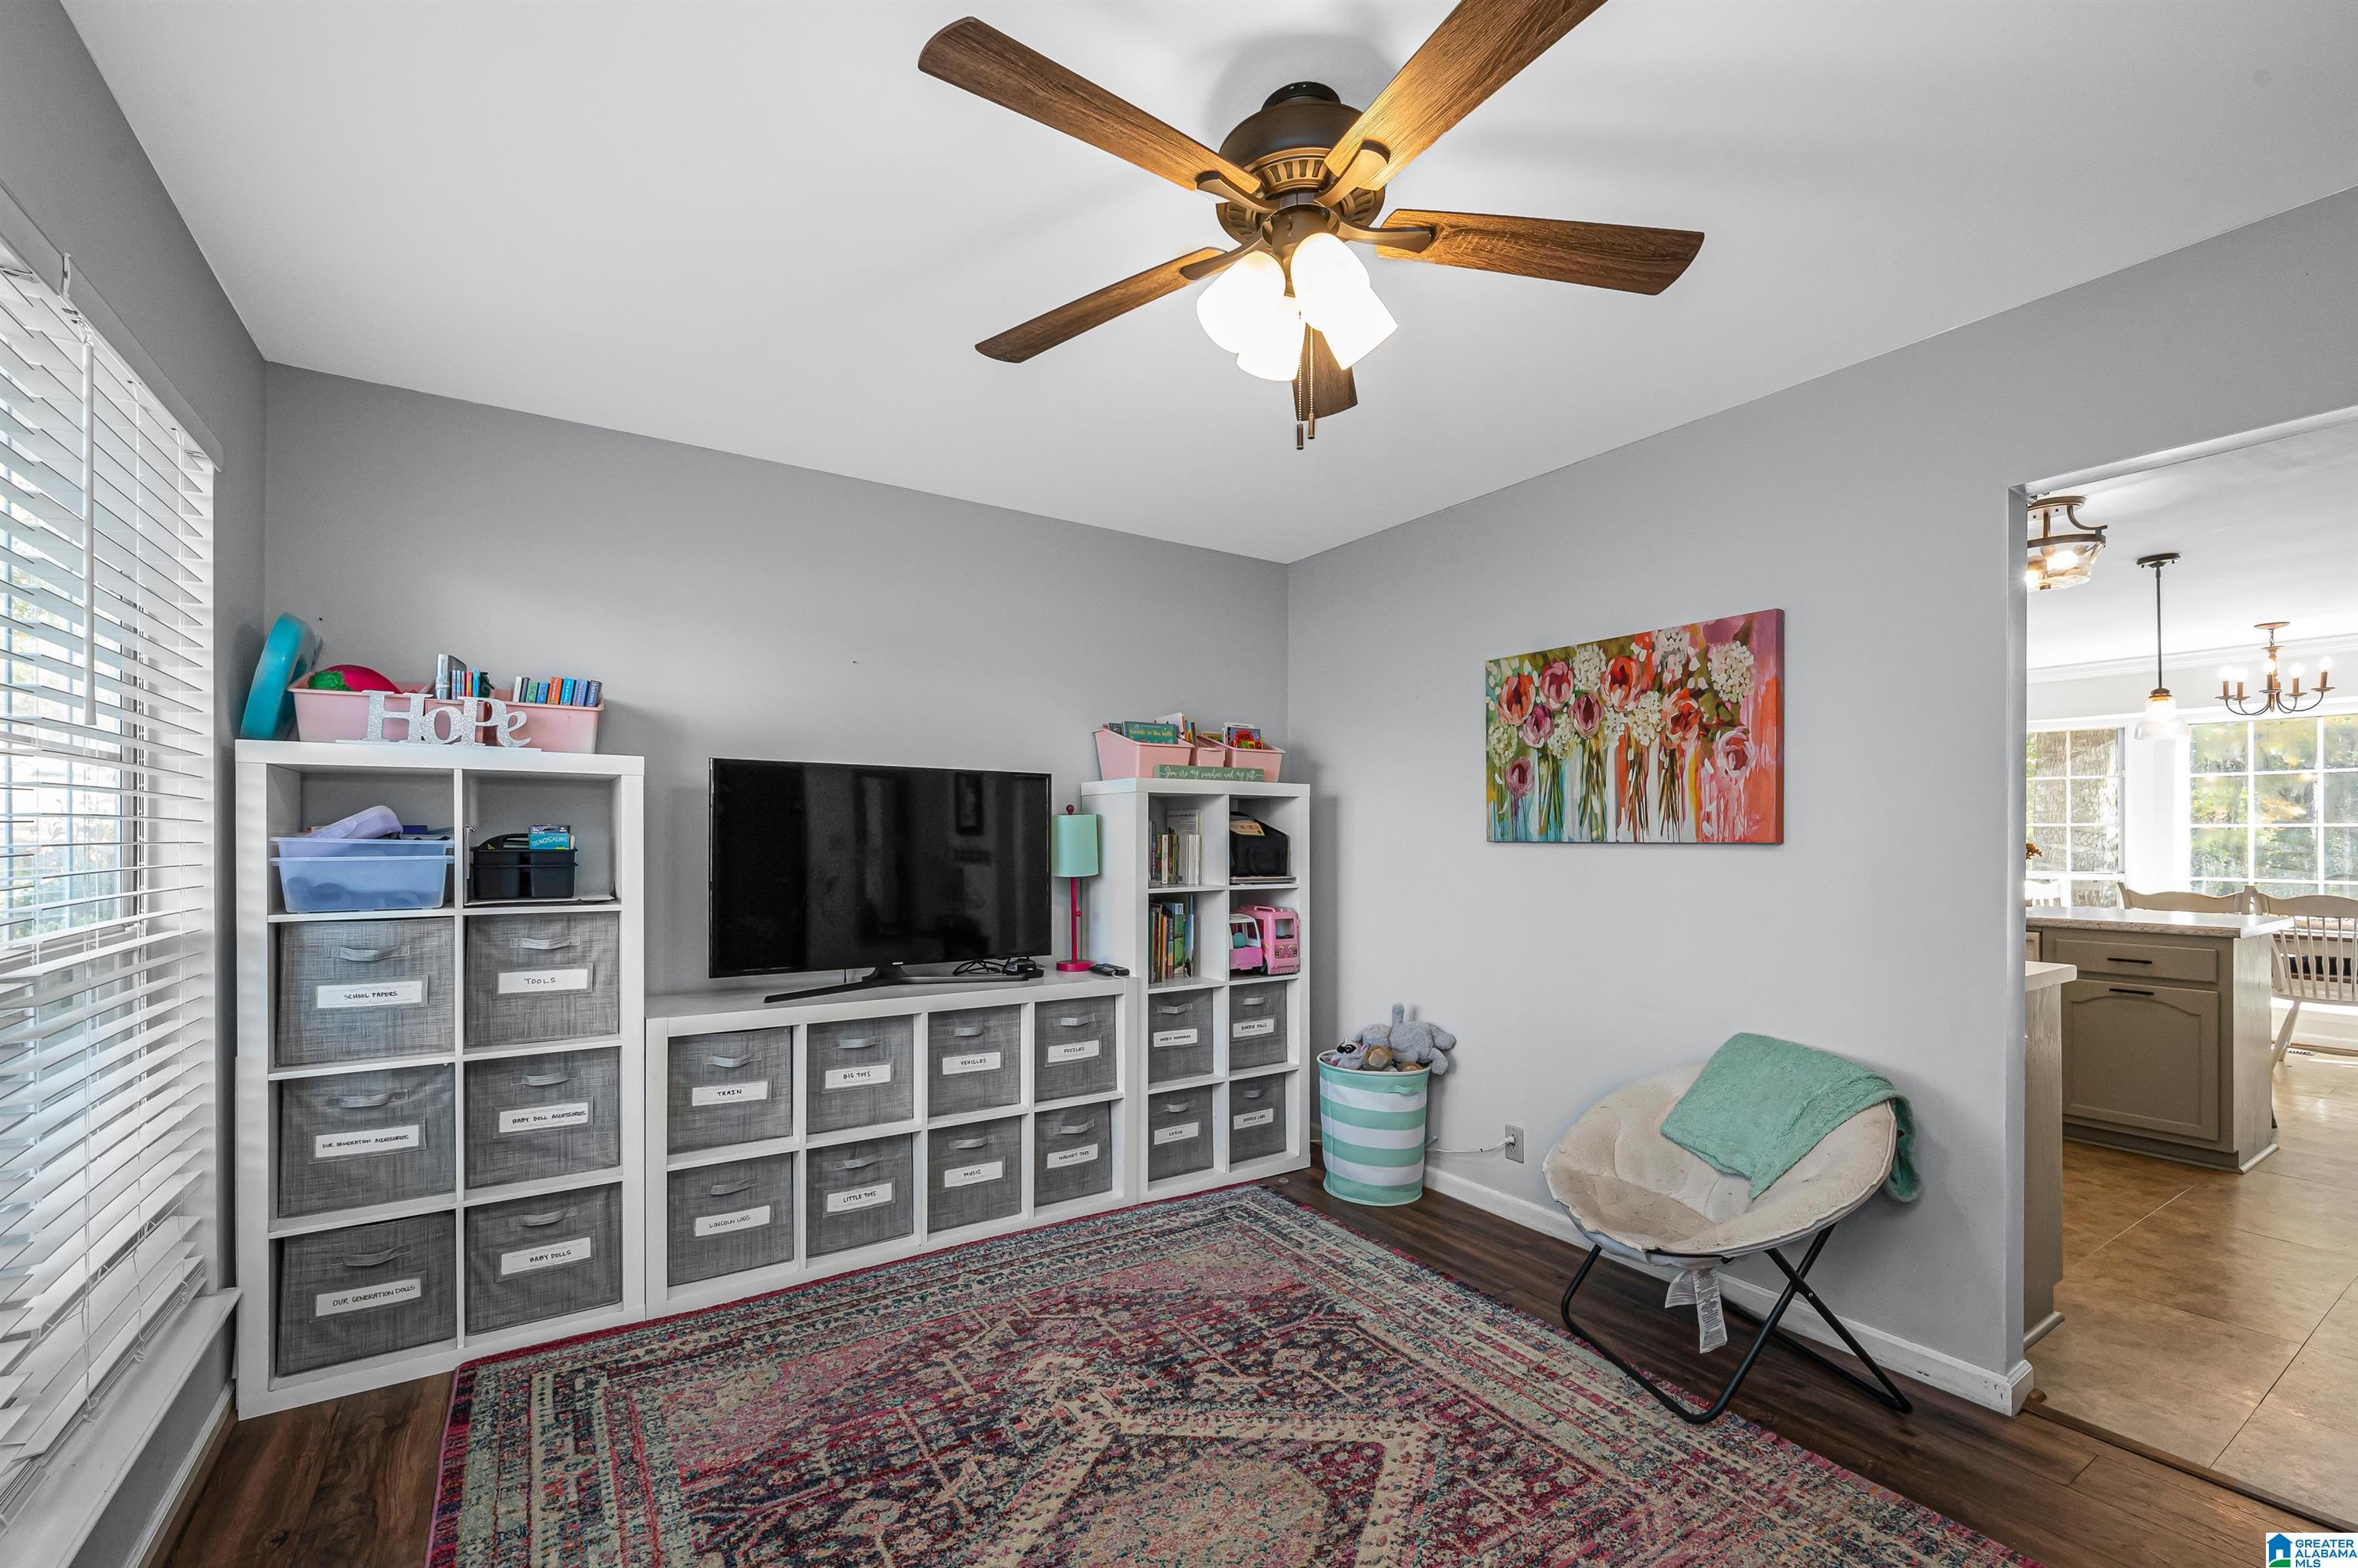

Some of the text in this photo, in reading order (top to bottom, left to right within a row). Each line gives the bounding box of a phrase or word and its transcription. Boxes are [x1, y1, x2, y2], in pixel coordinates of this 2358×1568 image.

[531, 837, 568, 847] DINOSAURS
[959, 1058, 987, 1066] VEHICLES
[716, 1088, 742, 1097] TRAIN
[551, 1110, 587, 1119] ACCESSORIES
[336, 1138, 372, 1147] GENERATION
[963, 1168, 982, 1177] MUSIC
[843, 1193, 862, 1203] LITTLE
[708, 1214, 751, 1229] LINCOLN LOGS
[529, 1249, 572, 1263] BABY DOLLS
[332, 1285, 416, 1307] OUR GENERATION DOLLS
